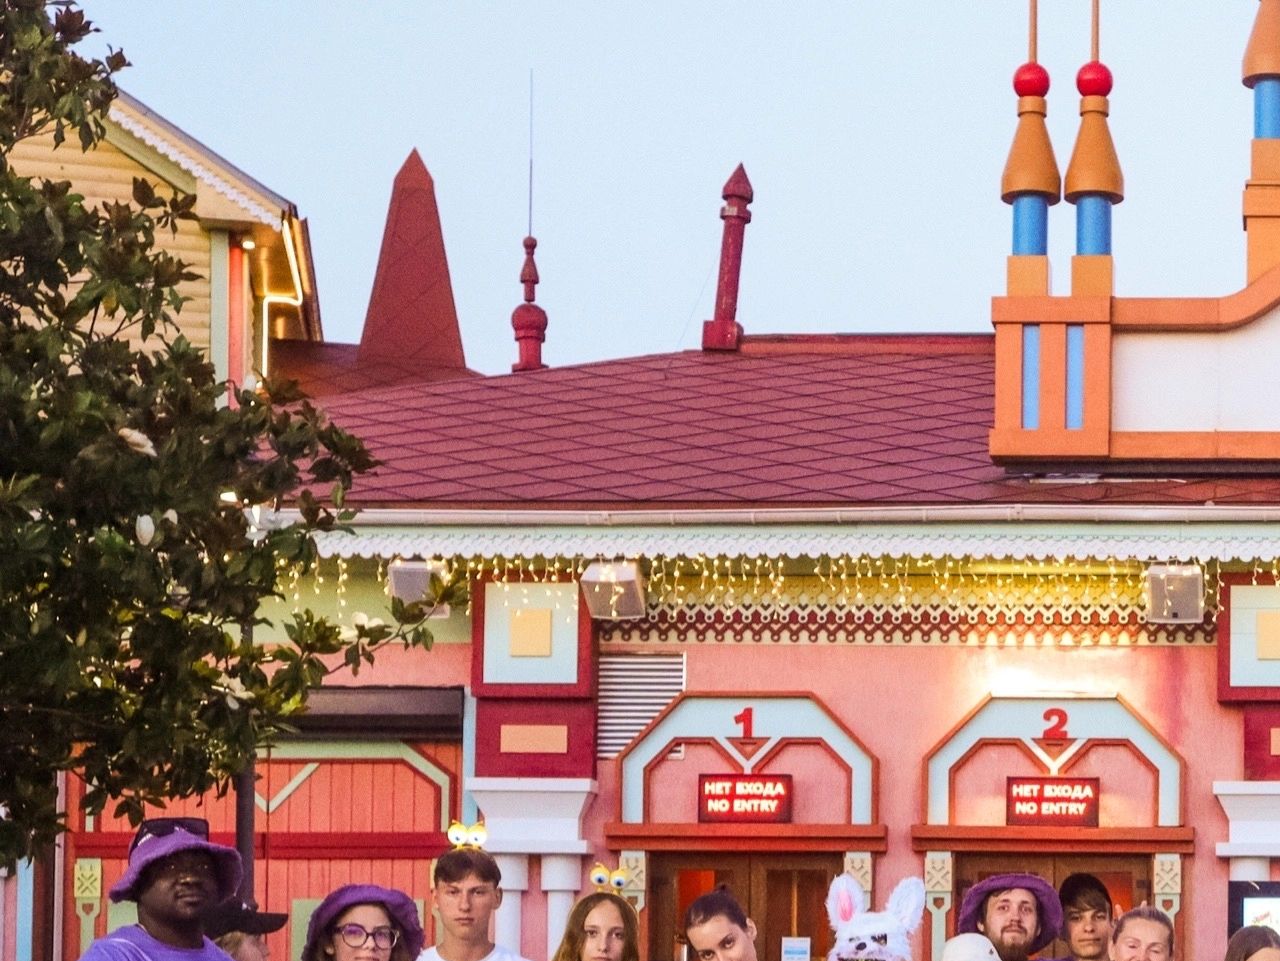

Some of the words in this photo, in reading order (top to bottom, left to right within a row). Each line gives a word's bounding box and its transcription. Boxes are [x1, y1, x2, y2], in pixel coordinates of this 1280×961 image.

[734, 707, 753, 739] 1
[1043, 708, 1068, 739] 2
[704, 782, 731, 795] НЕТ
[736, 782, 785, 797] ВХОДА
[1012, 784, 1040, 797] НЕТ
[1043, 785, 1093, 800] ВХОДА
[707, 800, 730, 812] NO
[733, 800, 778, 812] ENTRY
[1015, 802, 1038, 814] NO
[1041, 803, 1086, 815] ENTRY
